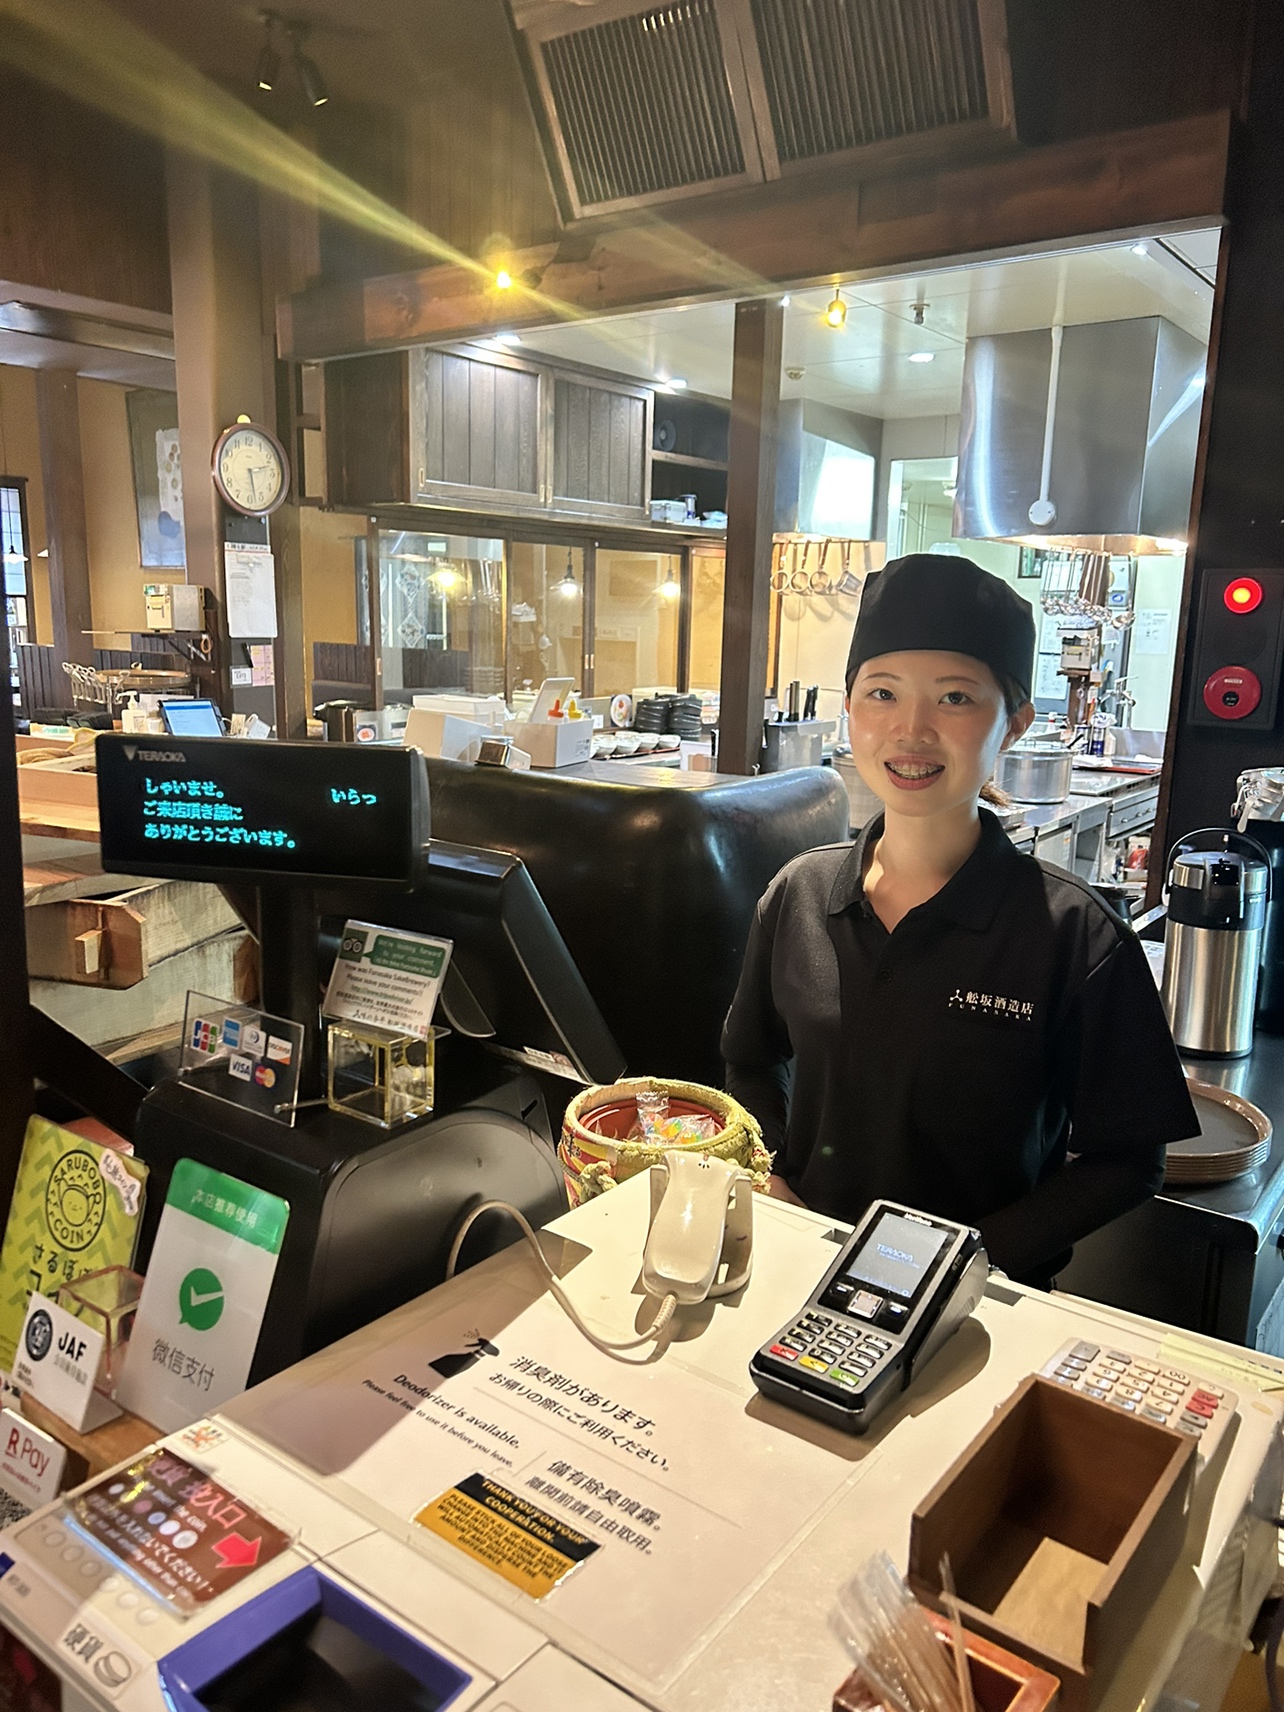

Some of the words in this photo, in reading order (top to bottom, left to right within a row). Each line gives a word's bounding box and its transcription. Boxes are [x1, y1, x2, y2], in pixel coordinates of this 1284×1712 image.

[234, 438, 240, 449] 11
[245, 436, 253, 447] 12
[258, 442, 262, 452] 1
[223, 463, 229, 472] 9
[266, 454, 272, 464] 2
[226, 478, 232, 488] 8
[270, 468, 275, 478] 3
[235, 490, 241, 499] 7
[247, 495, 253, 504] 6
[259, 492, 264, 502] 5
[266, 483, 272, 492] 4
[138, 750, 186, 762] TERAOKA
[145, 778, 224, 799] しゃいませ。
[331, 788, 377, 805] いらっ
[144, 823, 295, 848] ありがとうございます。
[419, 947, 442, 957] forward
[346, 973, 363, 982] Please
[377, 981, 390, 989] your
[233, 1061, 250, 1075] VISA
[54, 1157, 102, 1205] SARUBOBO
[54, 1218, 84, 1244] COIN
[58, 1332, 87, 1361] JAF
[152, 1338, 215, 1392] 微信支付
[509, 1356, 656, 1436] 消臭剤があります。
[362, 1379, 386, 1395] Please
[385, 1392, 401, 1403] feel
[400, 1398, 416, 1412] free
[416, 1409, 426, 1417] to
[425, 1415, 441, 1425] use
[440, 1422, 450, 1430] it
[448, 1427, 475, 1445] before
[472, 1442, 490, 1453] you
[393, 1374, 456, 1411] Deodorizer
[454, 1407, 467, 1418] is
[466, 1415, 520, 1449] available.
[489, 1373, 669, 1471] お帰りの際にご利用ください。
[21, 1437, 50, 1477] Pay
[547, 1460, 661, 1531] 備有除臭噴霧。
[172, 1504, 190, 1518] the
[482, 1481, 513, 1501] THANK
[512, 1500, 535, 1514] YOU
[533, 1512, 555, 1526] FOR
[555, 1525, 583, 1544] YOUR
[484, 1496, 557, 1542] COOPERATION.
[525, 1475, 652, 1555] 離開前請自由取用。
[437, 1504, 454, 1515] WILL
[455, 1515, 511, 1551] AUTOMATICALLY
[512, 1551, 537, 1567] COUNT
[538, 1567, 554, 1578] THE
[443, 1498, 469, 1516] CHANGE
[470, 1516, 488, 1527] INTO
[488, 1527, 503, 1536] THE
[504, 1536, 536, 1557] MACHINE
[537, 1557, 553, 1567] AND
[450, 1494, 474, 1510] PLEASE
[475, 1510, 496, 1523] STICK
[496, 1523, 510, 1531] ALL
[521, 1538, 542, 1551] YOUR
[542, 1551, 566, 1567] LOOSE
[440, 1515, 469, 1534] AMOUNT
[470, 1534, 486, 1544] AND
[521, 1566, 537, 1577] THE
[141, 1556, 164, 1575] other
